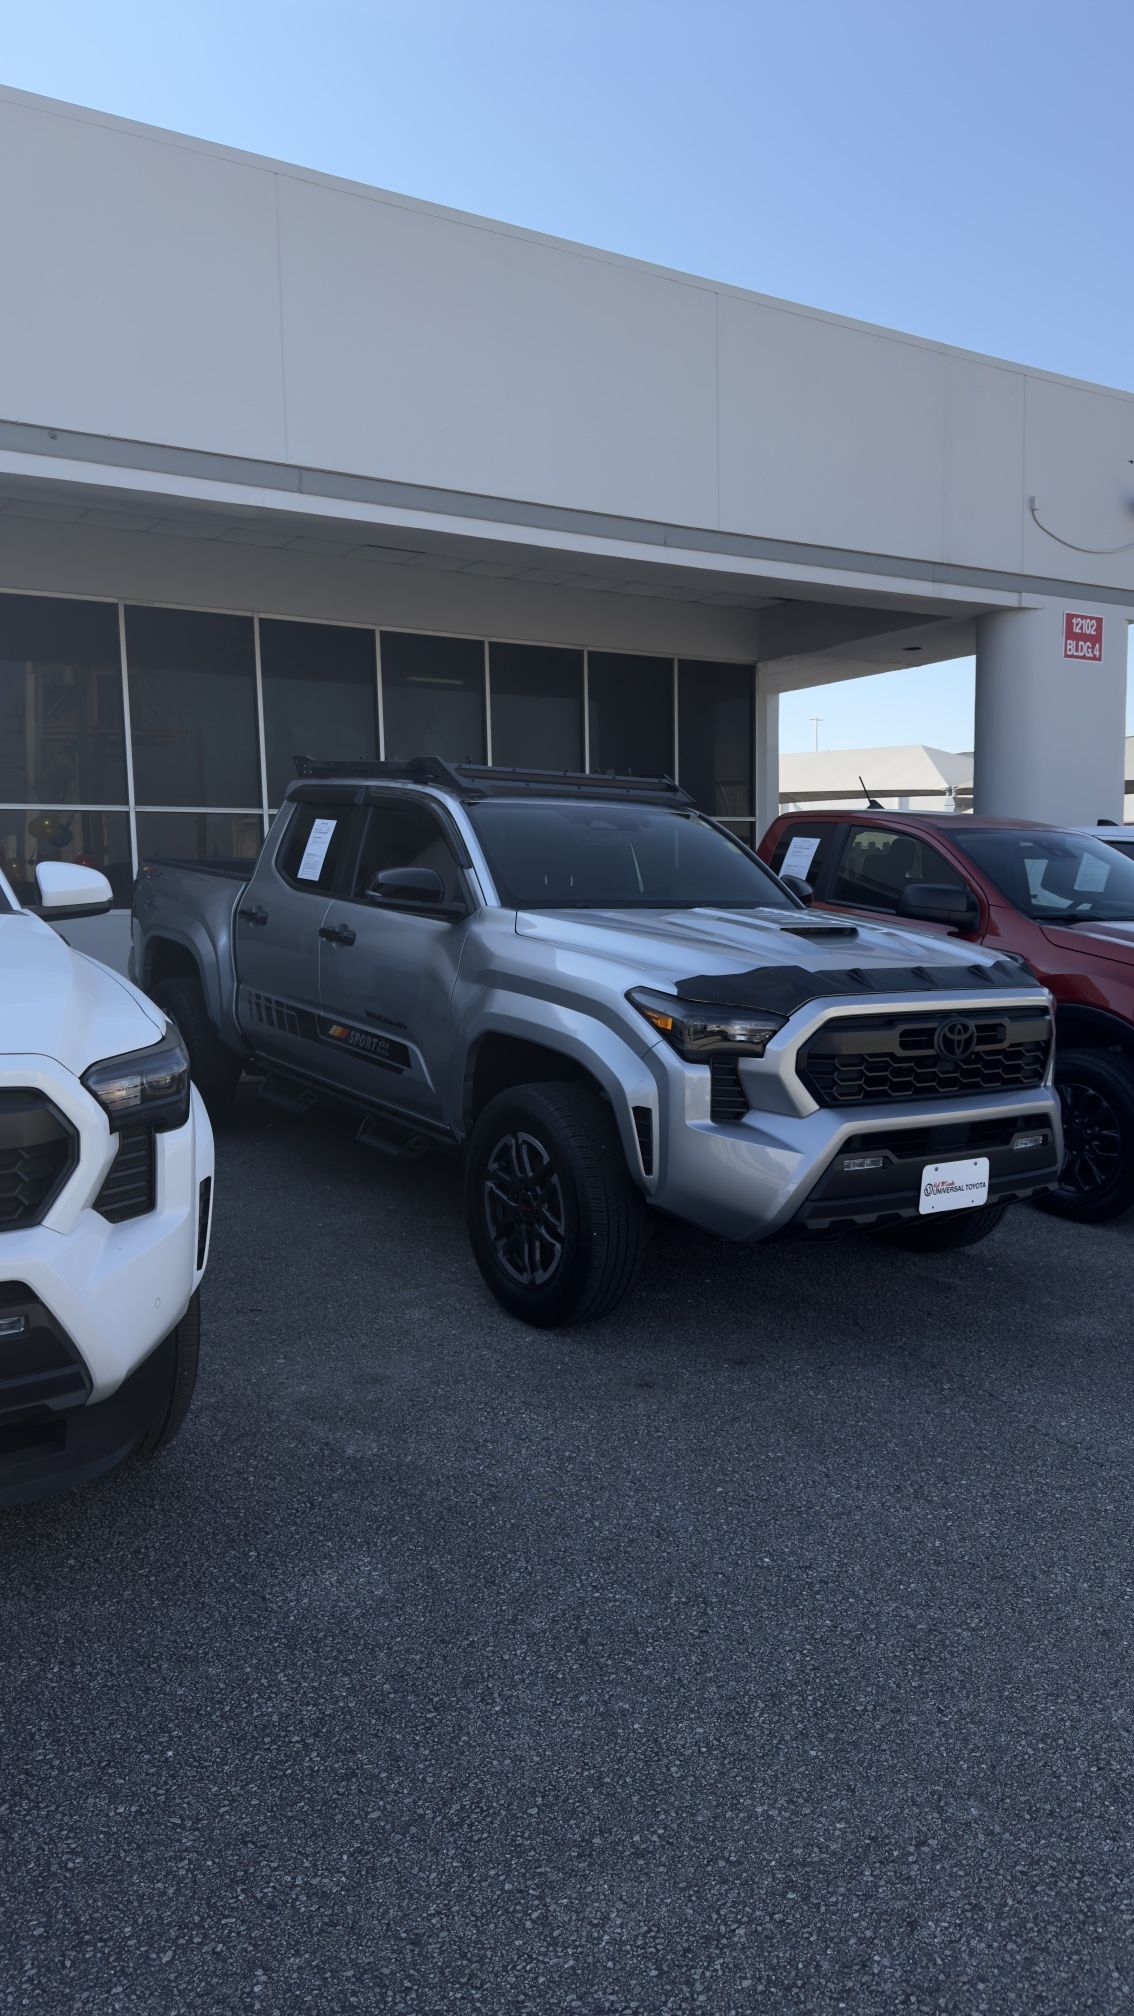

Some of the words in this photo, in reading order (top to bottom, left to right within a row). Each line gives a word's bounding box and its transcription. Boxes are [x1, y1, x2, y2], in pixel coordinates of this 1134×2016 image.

[1072, 618, 1097, 635] 12102
[349, 1030, 378, 1051] SPORT
[933, 1185, 965, 1195] UNIVERSAL
[965, 1182, 987, 1191] TOYOTA
